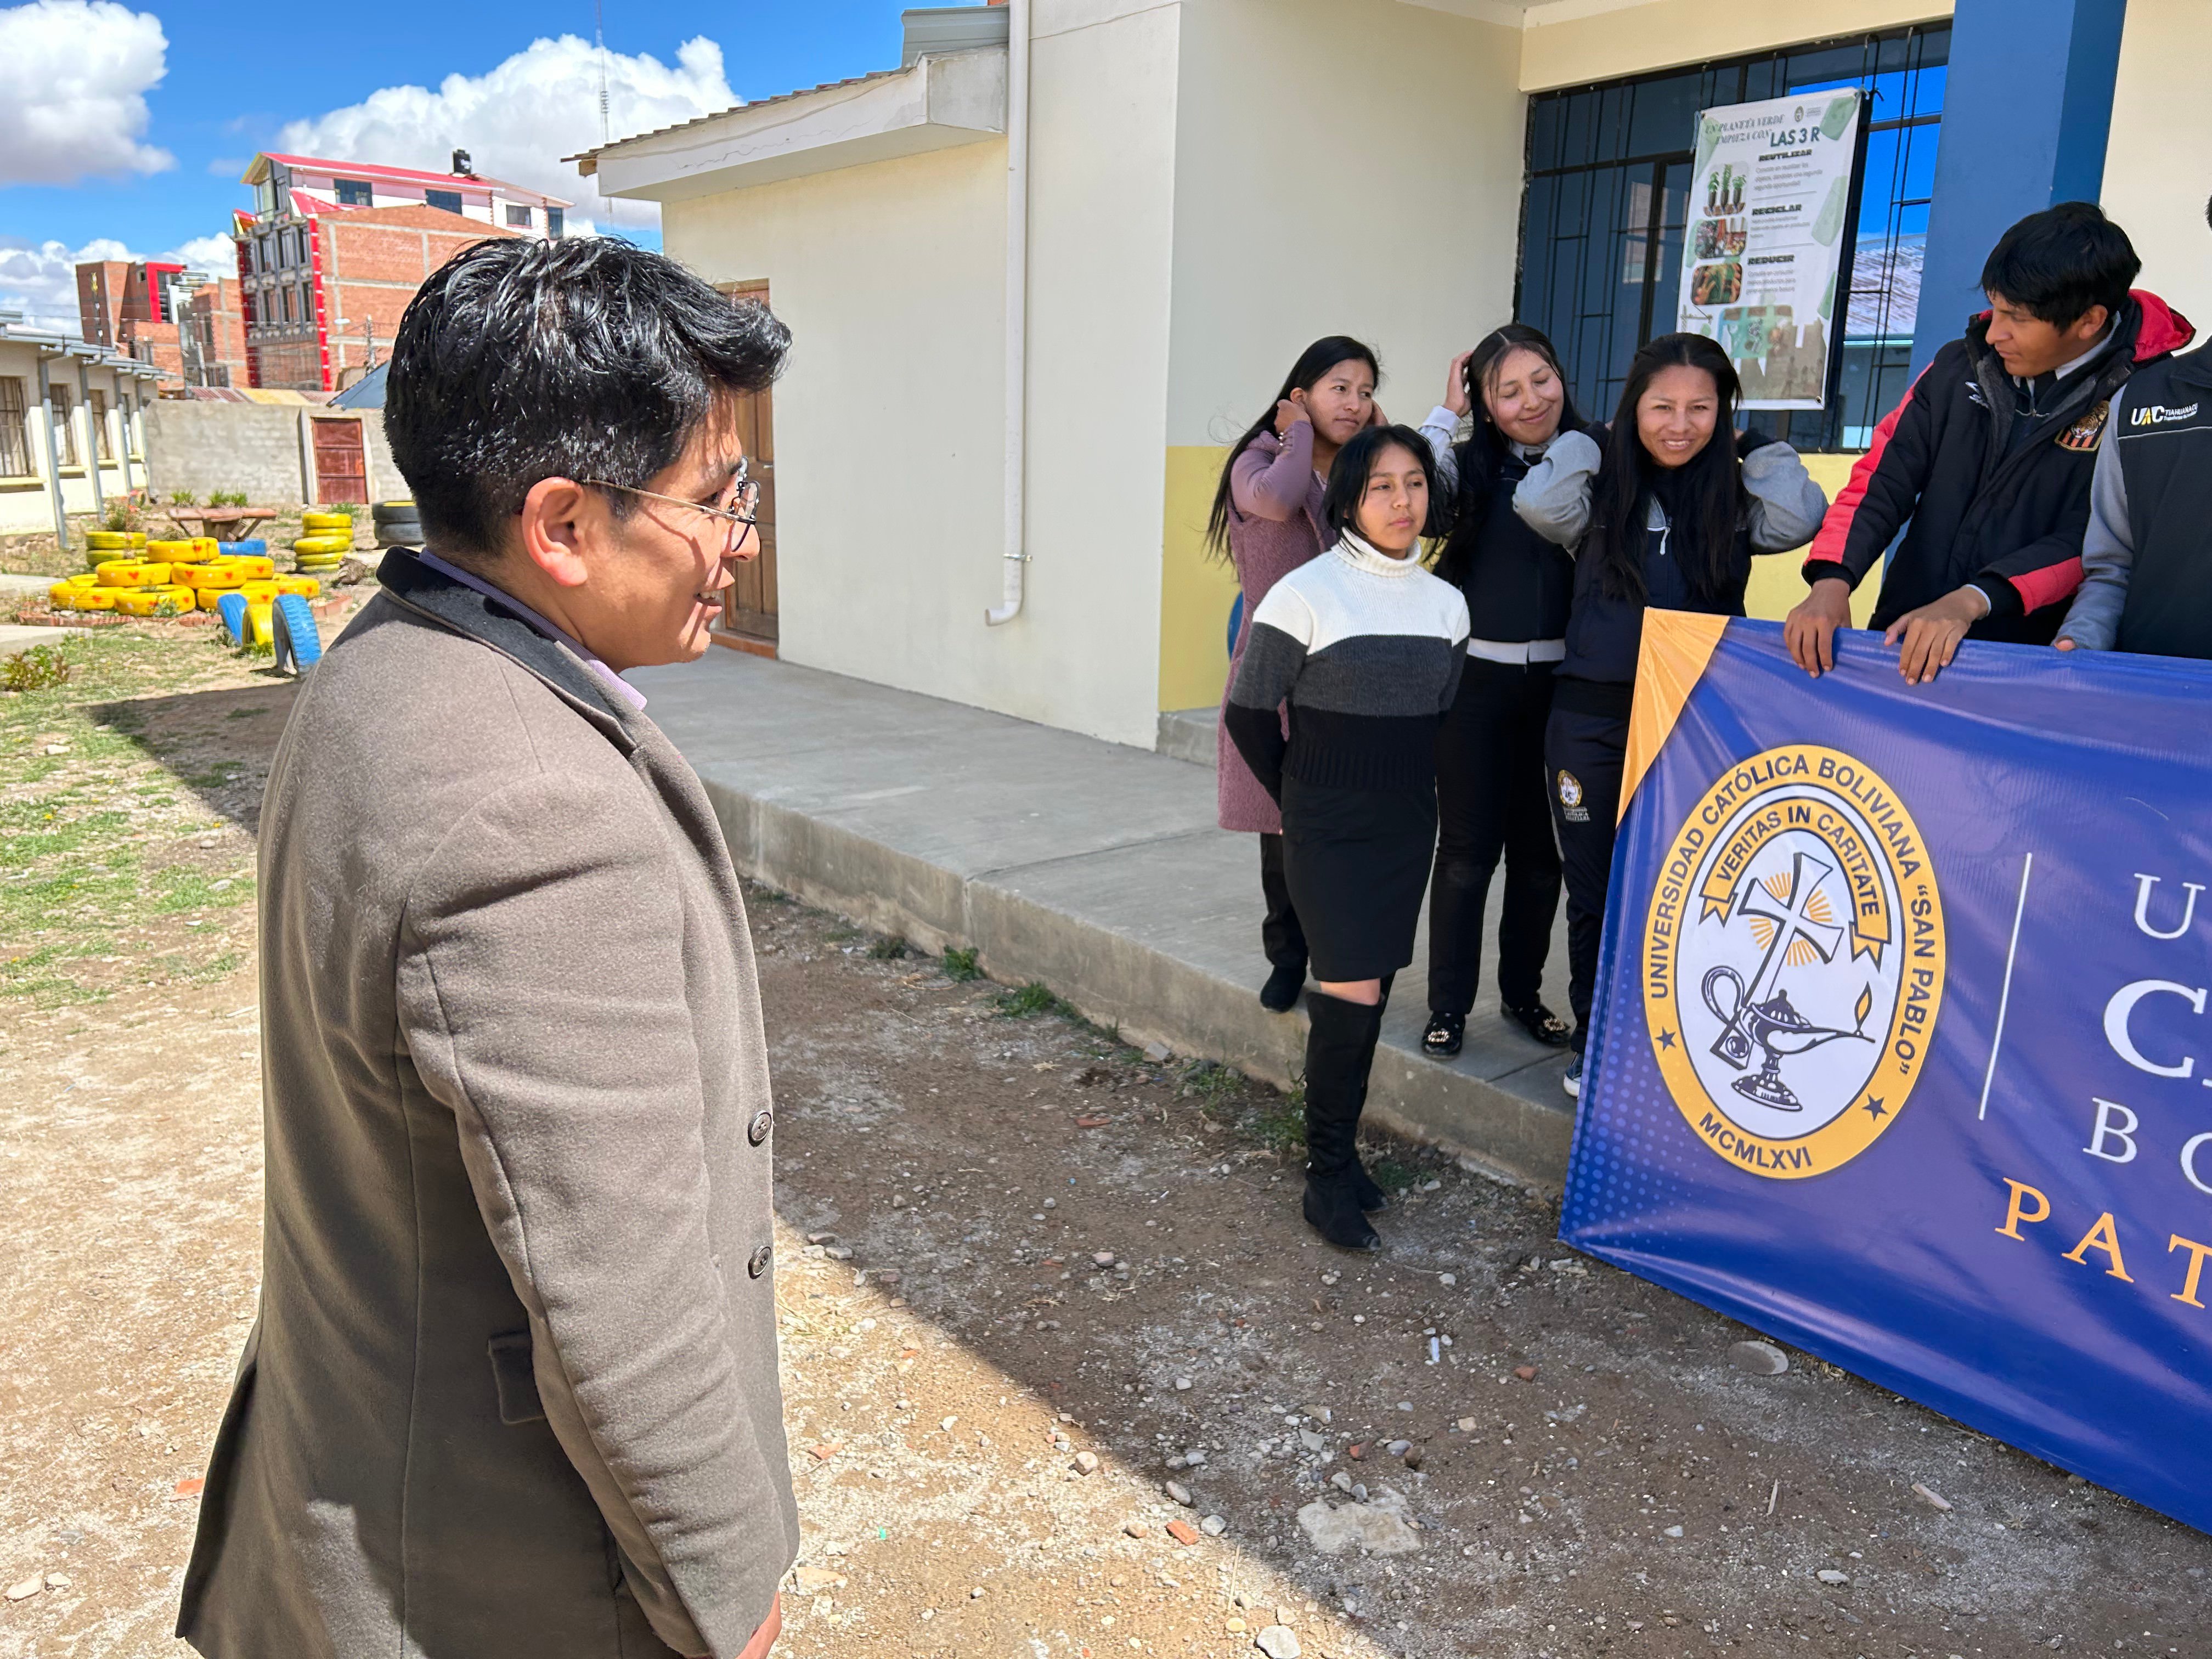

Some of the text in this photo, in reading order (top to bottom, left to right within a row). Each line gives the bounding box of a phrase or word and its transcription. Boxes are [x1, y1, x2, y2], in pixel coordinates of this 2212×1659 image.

[1757, 114, 1785, 126] VERDE
[1716, 126, 1820, 147] EMPIEZA CON LAS 3 R
[1758, 149, 1812, 162] REUTILIZAR
[1752, 204, 1802, 216] RECICLAR
[1747, 254, 1795, 266] REDUCIR
[2131, 405, 2165, 425] UAC
[1716, 805, 1880, 917] VERITAS IN CARITATE
[1651, 827, 1705, 998] UNIVERSIDAD
[1702, 754, 1809, 826] CATÓLICA
[1818, 756, 1921, 879] BOLIVIANA
[1699, 1110, 1813, 1170] MCMLXVI
[1994, 1176, 2212, 1309] PAT
